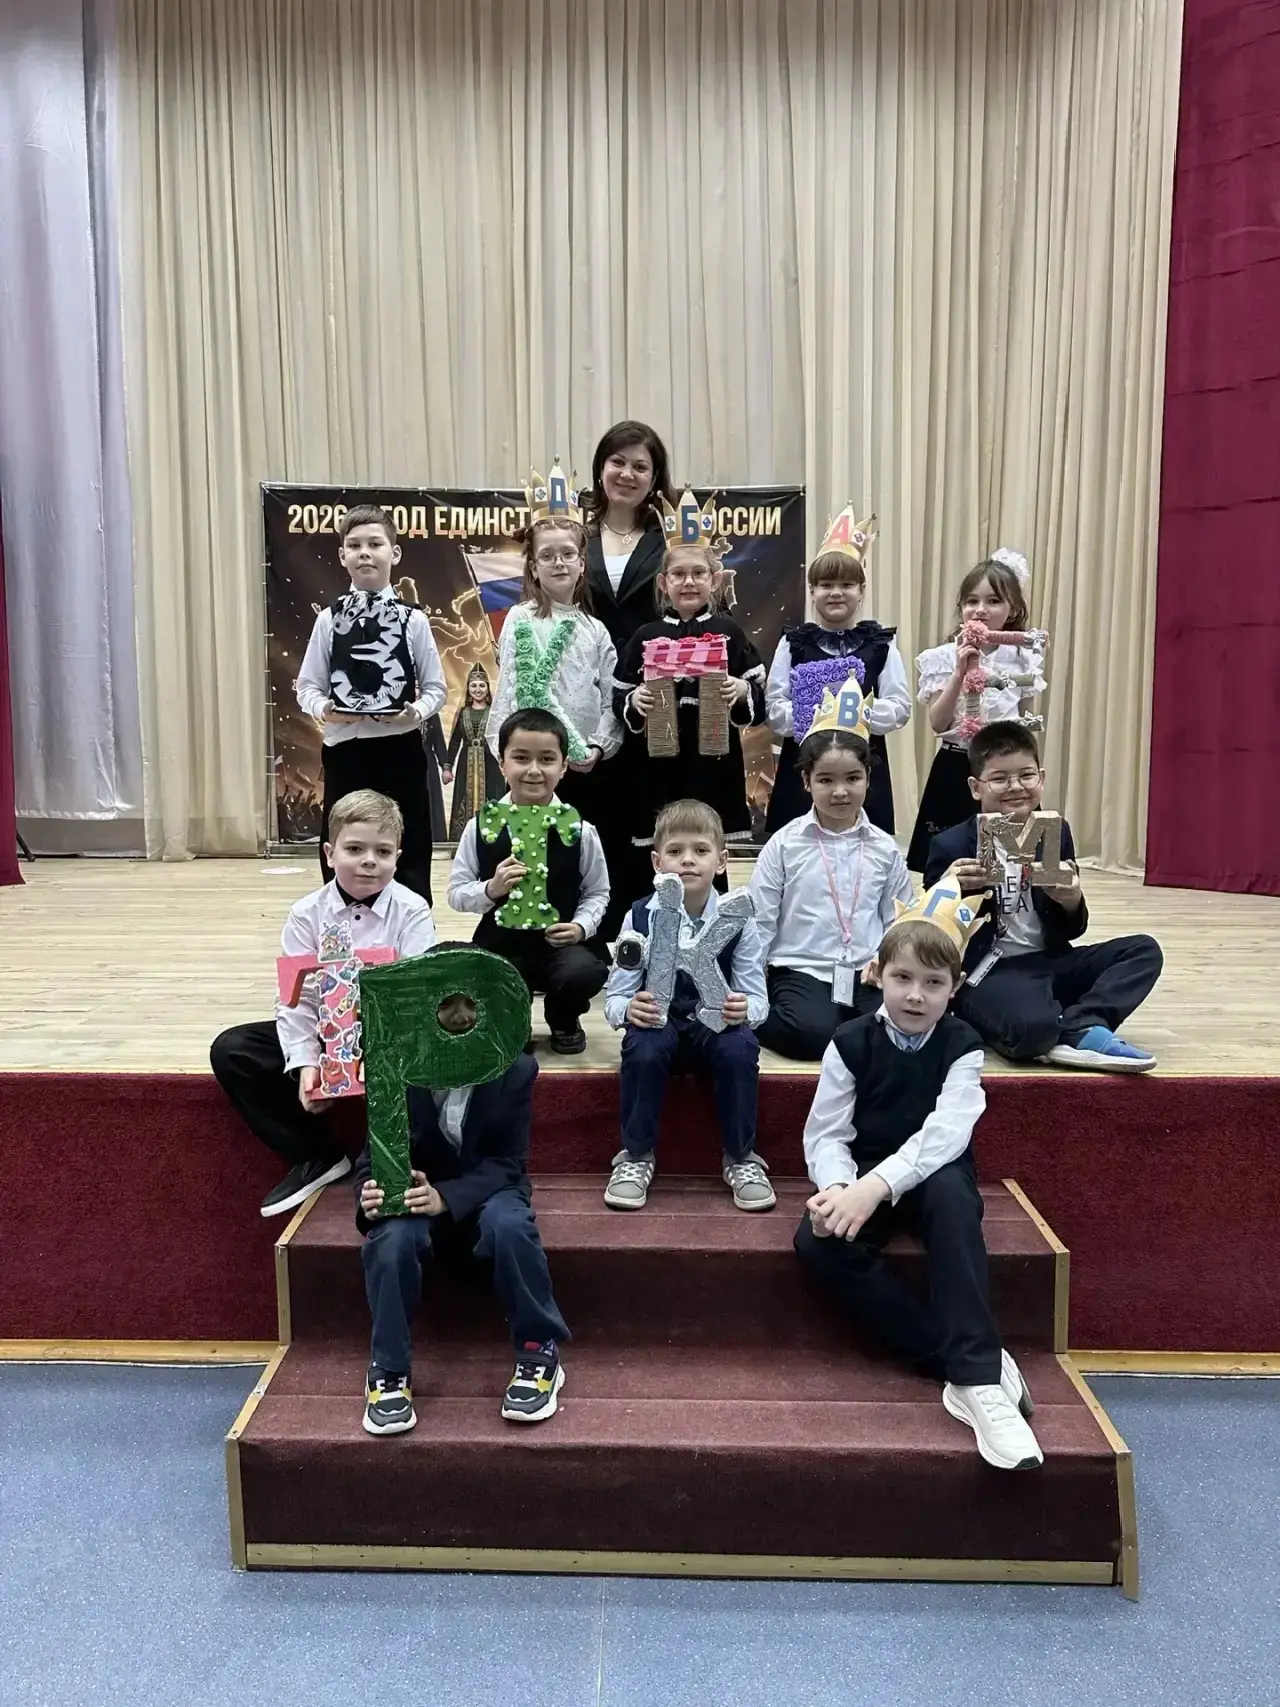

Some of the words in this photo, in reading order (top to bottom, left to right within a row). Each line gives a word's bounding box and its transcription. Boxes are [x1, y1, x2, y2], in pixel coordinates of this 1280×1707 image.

[548, 477, 569, 515] Д
[287, 504, 348, 534] 2026
[434, 506, 533, 539] ЕДИНСТ
[681, 504, 700, 543] Б
[824, 515, 850, 547] А
[837, 691, 861, 728] В
[922, 888, 958, 918] Г
